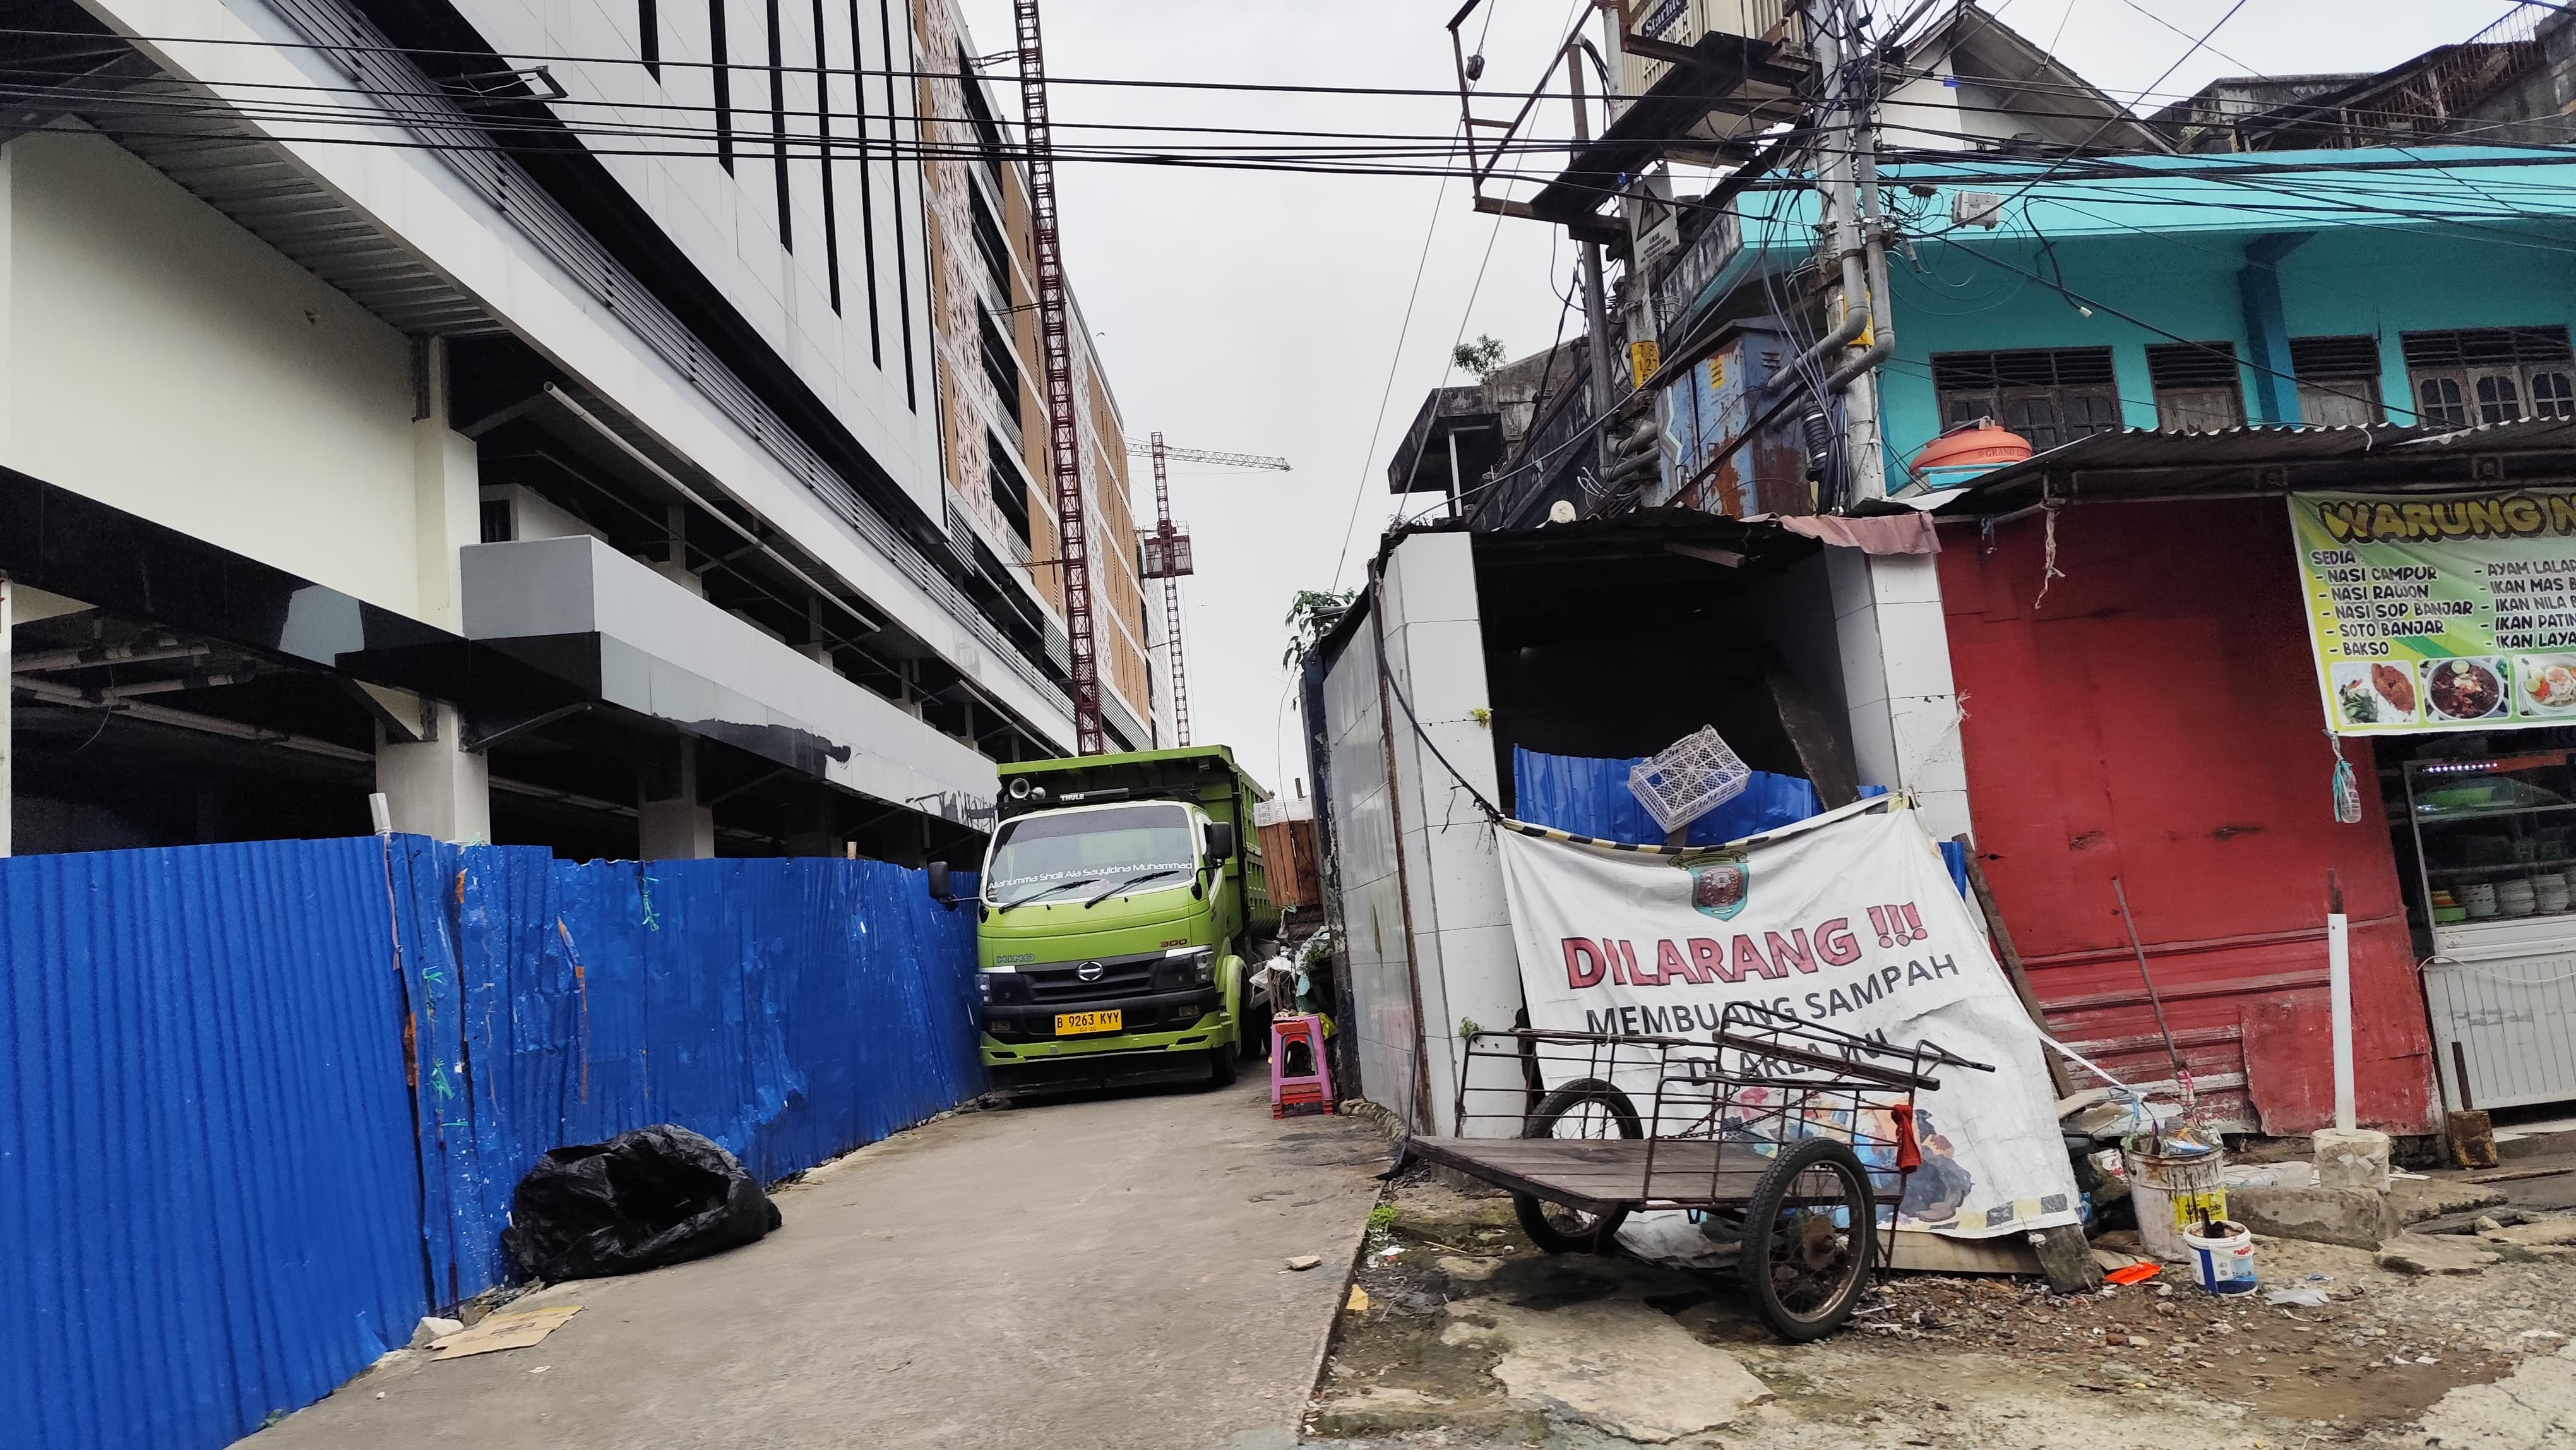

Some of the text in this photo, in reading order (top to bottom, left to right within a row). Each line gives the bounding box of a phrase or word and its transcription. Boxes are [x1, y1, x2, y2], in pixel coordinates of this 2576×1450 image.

[1985, 448, 2015, 457] GRAND
[2318, 496, 2547, 544] WARUNG
[2311, 550, 2356, 565] SEDIA
[2327, 566, 2438, 583] NASI CAMPUR
[2488, 561, 2531, 576] AYAM
[2331, 585, 2429, 601] NASI RAWON
[2490, 580, 2525, 594] IKAN
[2530, 577, 2564, 592] MAS
[2335, 601, 2473, 619] NASI SOP BANJAR
[2495, 597, 2531, 612] IKAN
[2533, 596, 2567, 610] NILA
[2339, 620, 2445, 637] SOTO BANJAR
[2495, 615, 2532, 630] IKAN
[2343, 641, 2388, 656] BAKSO
[2496, 633, 2532, 649] IKAN
[1061, 793, 1085, 801] THULE
[1065, 870, 1081, 878] Ala
[1083, 865, 1131, 876] Sayyidina
[1133, 862, 1193, 872] Muhammad
[1160, 938, 1188, 947] 300
[996, 954, 1035, 964] HINO
[1561, 917, 1862, 989] DILARANG
[1586, 954, 1960, 1036] MEMBUANG SAMPAH
[1057, 1012, 1119, 1028] B 9263 KYY
